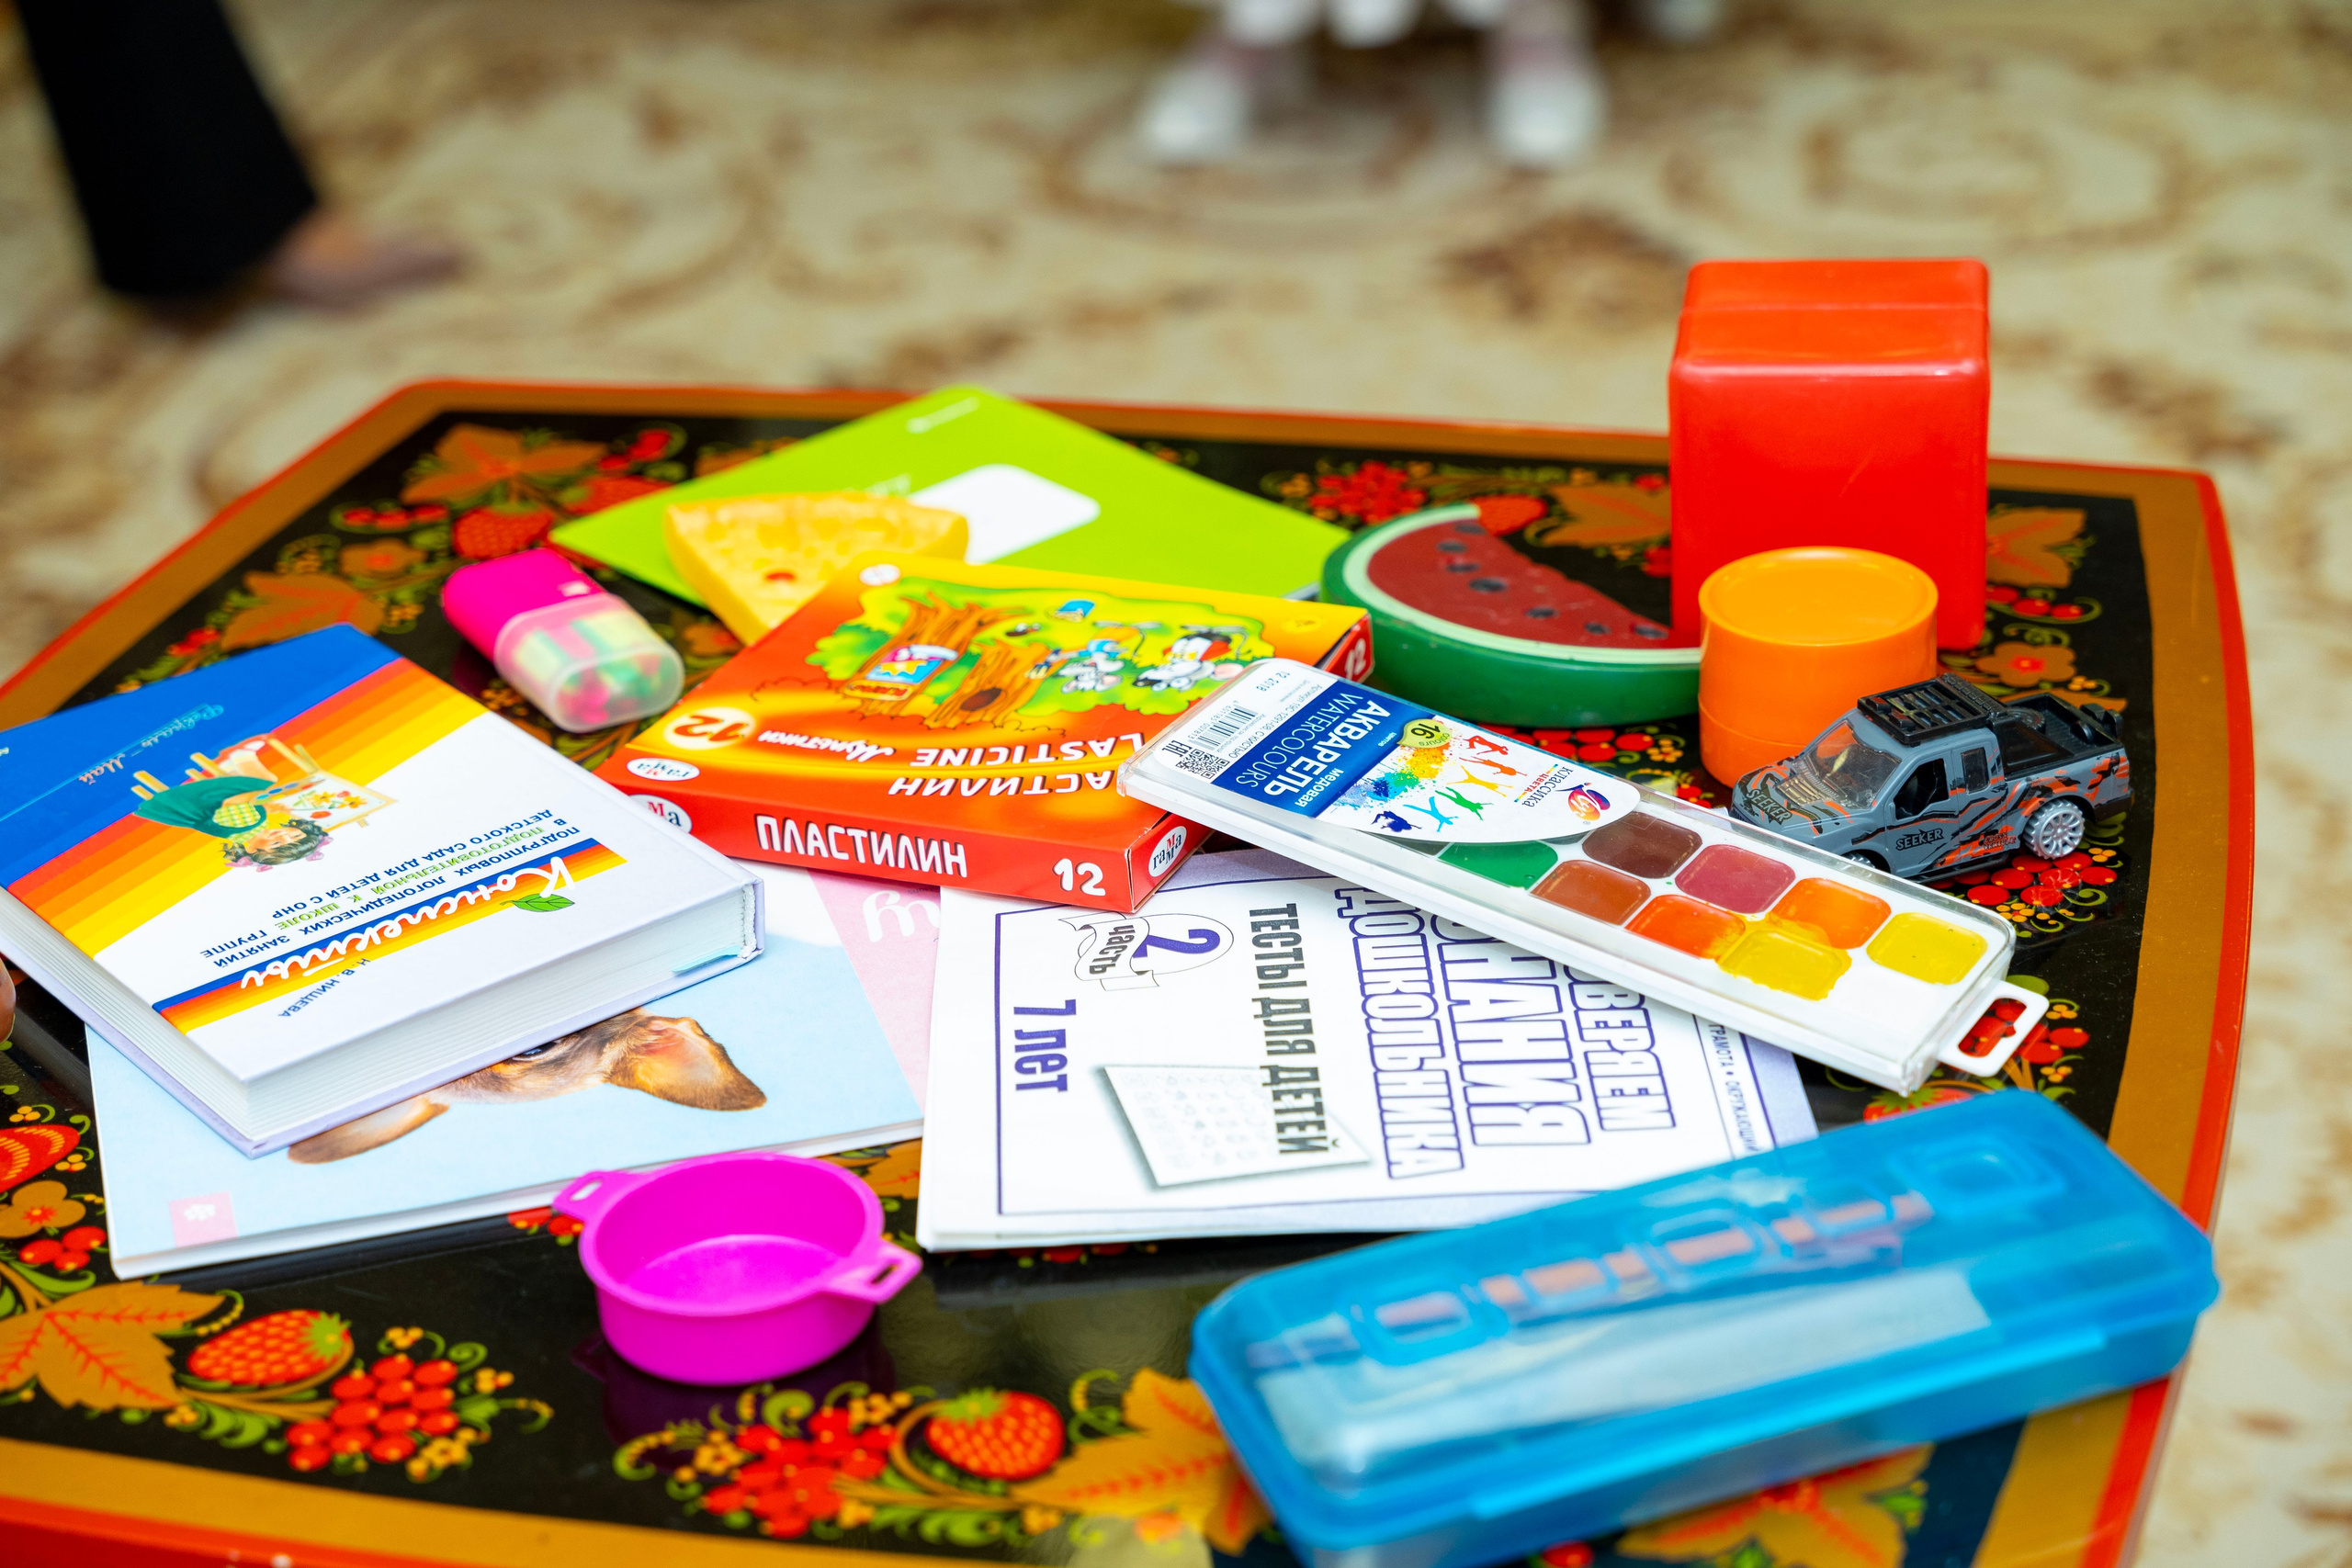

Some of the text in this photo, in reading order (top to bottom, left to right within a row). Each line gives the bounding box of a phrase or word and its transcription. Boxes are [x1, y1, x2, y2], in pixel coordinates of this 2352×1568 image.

[673, 715, 750, 742] 12
[1235, 693, 1364, 788] WATERCOLOURS
[1263, 700, 1391, 796] АКВАРЕЛЬ
[1410, 722, 1441, 739] 16
[1419, 732, 1450, 746] colours
[78, 753, 126, 785] Май
[909, 732, 1145, 768] LASTICINE
[888, 770, 1115, 797] АСТИЛИН
[1295, 767, 1344, 807] медовая
[1521, 766, 1574, 807] классика
[1524, 773, 1549, 793] ЦВЕТА
[1747, 789, 1792, 823] SEEKER
[755, 813, 967, 878] ПЛАСТИЛИН
[1895, 829, 1944, 851] SEEKER
[271, 808, 553, 919] ДЕТСКОГО САДА ДЛЯ ДЕТЕЙ С ОНР
[1052, 858, 1106, 897] 12
[199, 817, 567, 958] В ПОДГОТОВИТЕЛЬНОЙ К ШКОЛЕ ГРУППЕ
[213, 825, 581, 969] ПОДГРУППОВЫХ ЛОГОПЕДИЧЕСКИХ ЗАНЯТИЙ
[240, 856, 576, 989] Конспекты
[1089, 924, 1136, 976] часть
[1133, 928, 1221, 959] 2
[278, 977, 341, 1018] НИЩЕВА
[1013, 998, 1077, 1092] 7 лет
[1249, 902, 1340, 1155] ТЕСТЫ ДЛЯ ДЕТЕЙ
[1334, 886, 1465, 1180] ДОШКОЛЬНИКА
[1563, 964, 1677, 1132] ВЕРЯЕМ
